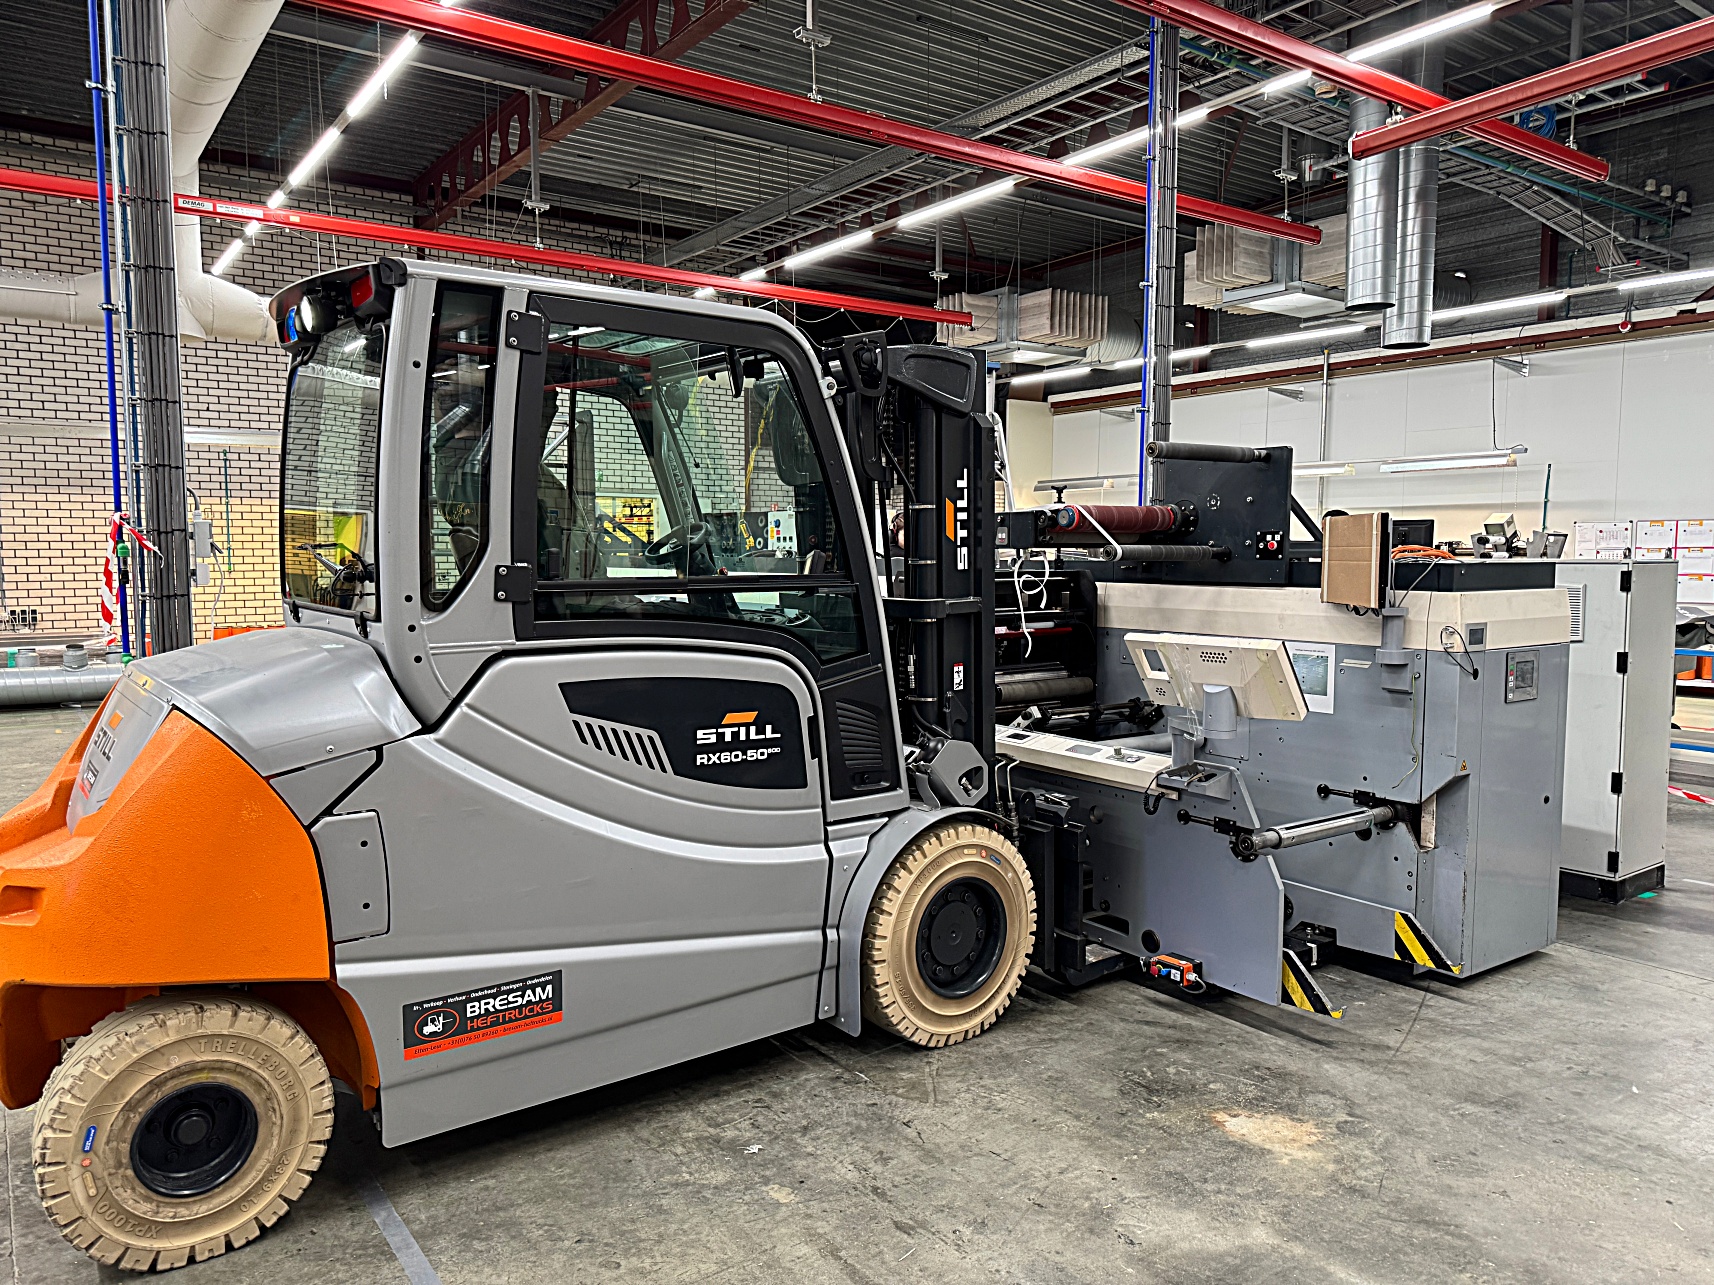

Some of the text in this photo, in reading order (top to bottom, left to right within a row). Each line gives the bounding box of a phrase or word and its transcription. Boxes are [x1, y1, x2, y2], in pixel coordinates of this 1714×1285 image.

[182, 199, 205, 208] DEMAG
[956, 468, 968, 570] STILL
[94, 725, 117, 762] STILL
[696, 724, 781, 745] STILL
[466, 984, 553, 1018] BRESAM
[467, 1000, 553, 1031] HEFTRUCKS
[198, 1038, 300, 1102] TRELLEBORG
[96, 1201, 162, 1239] XP1000
